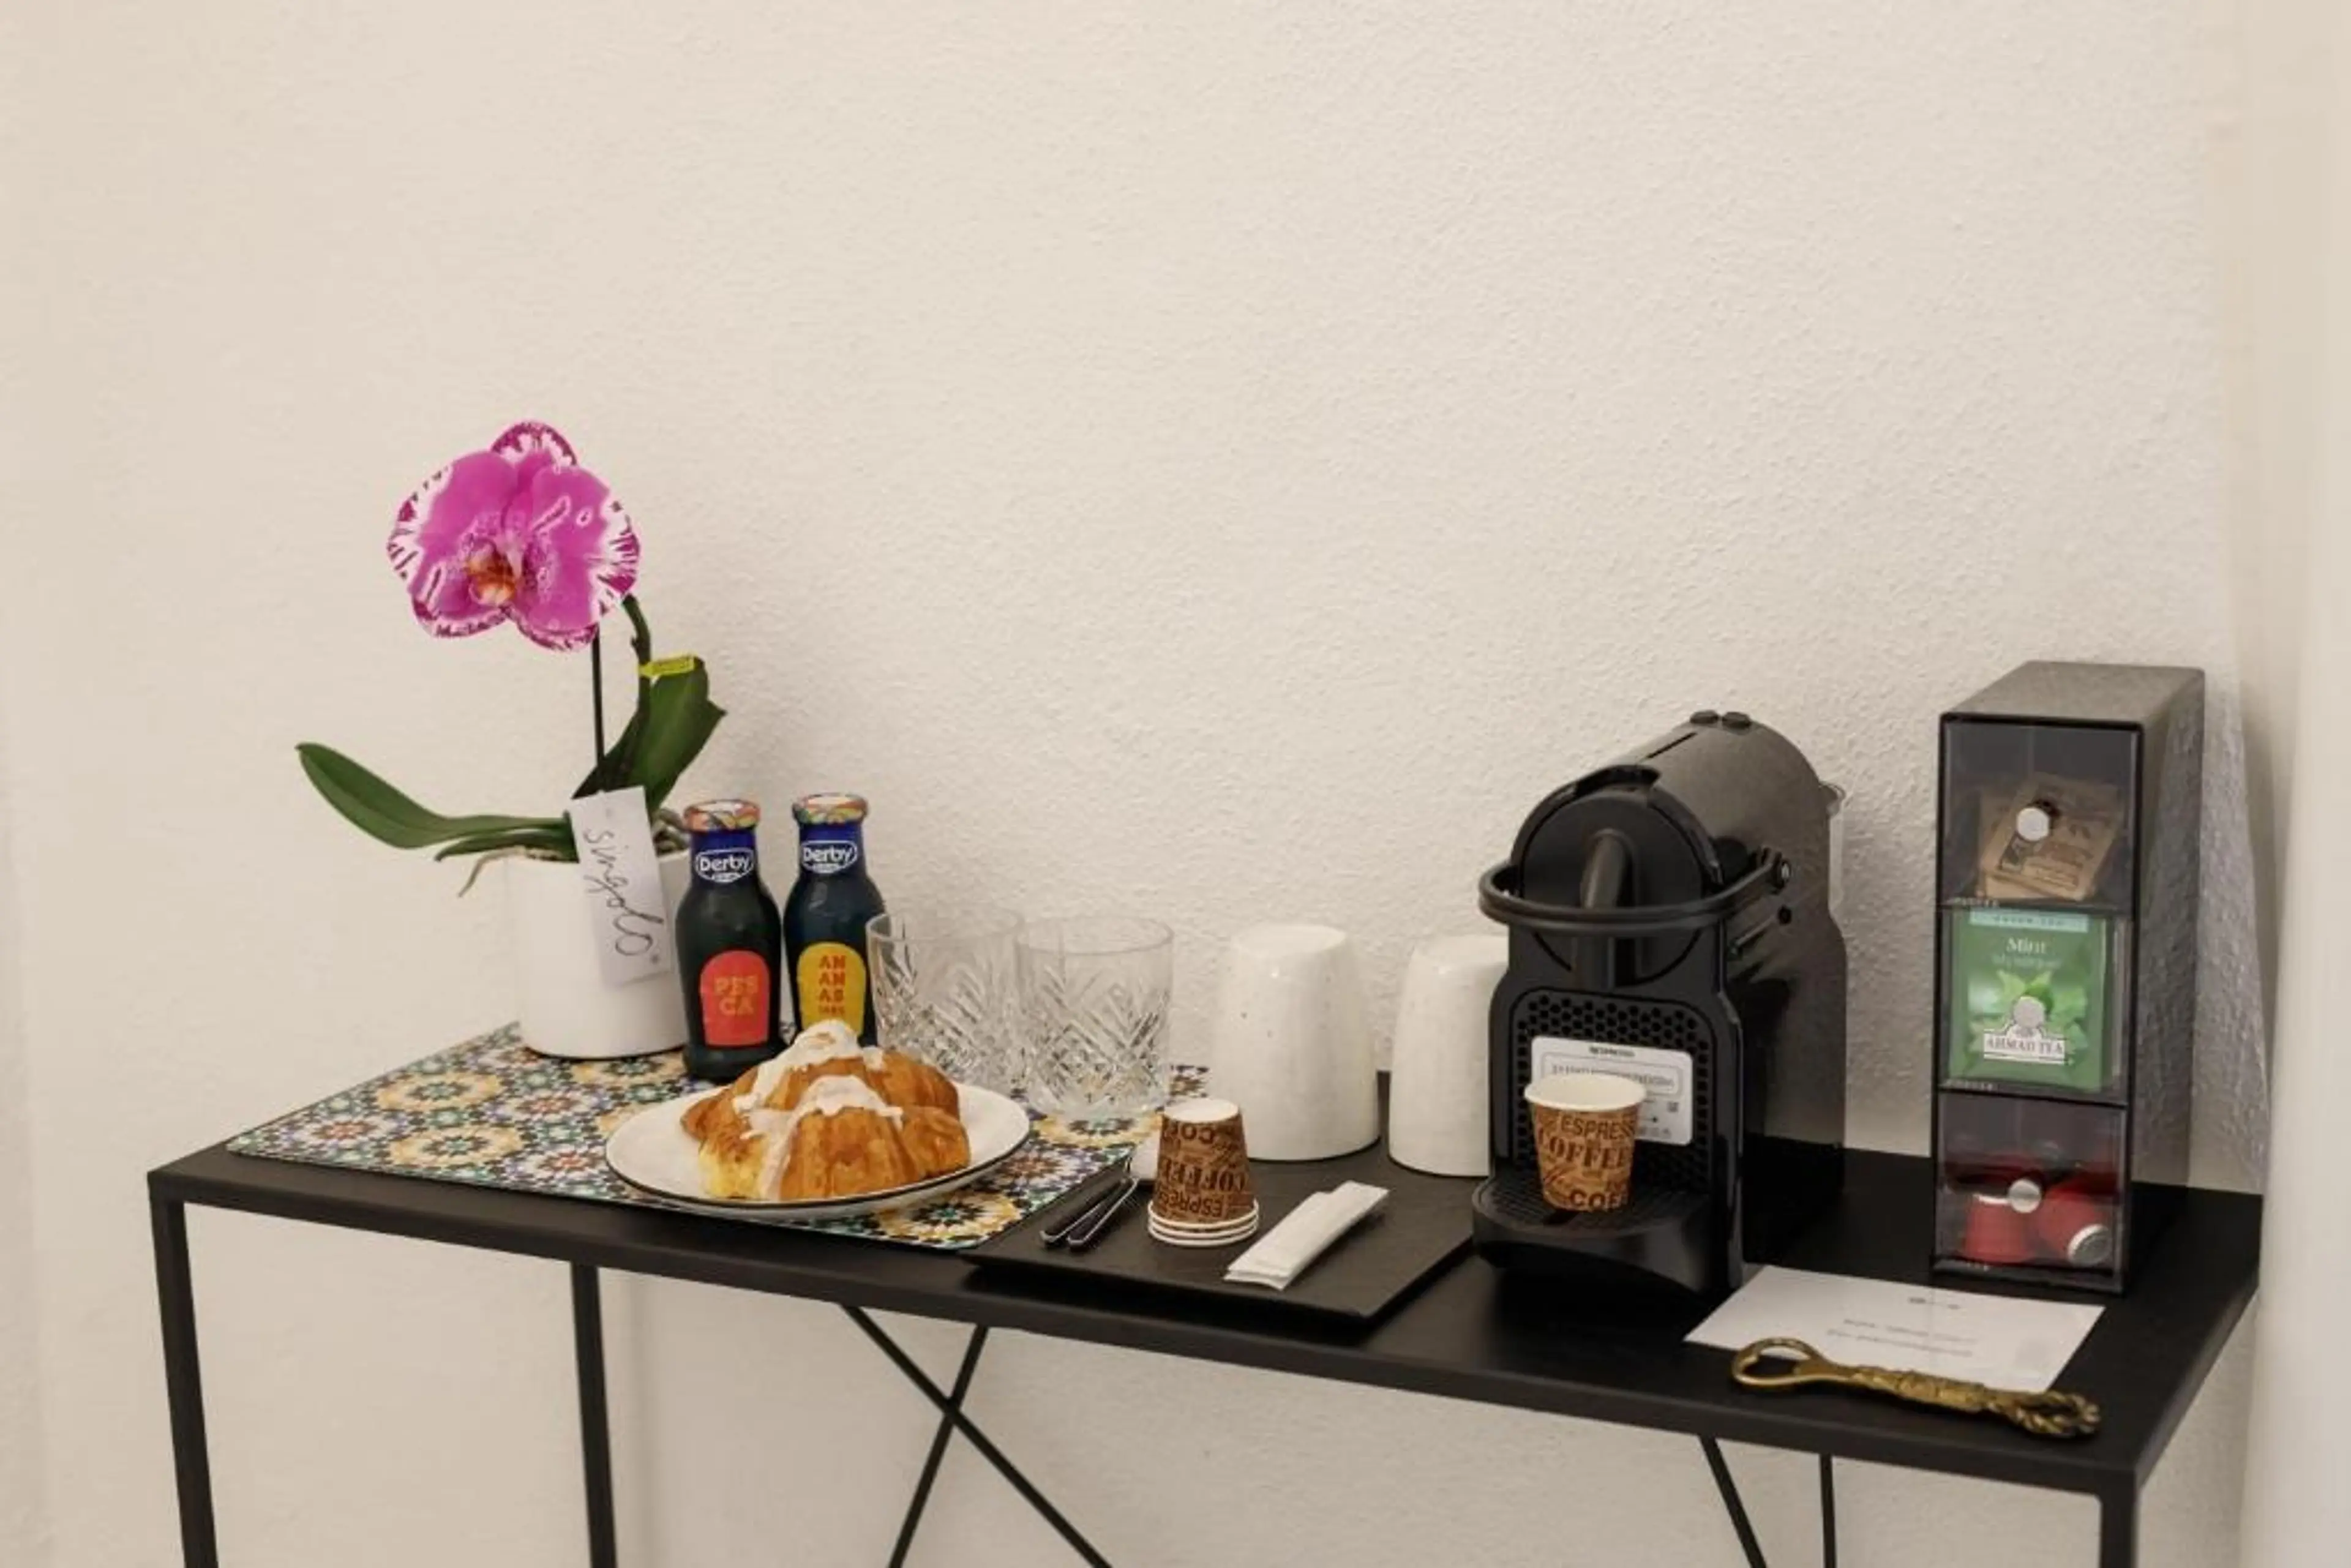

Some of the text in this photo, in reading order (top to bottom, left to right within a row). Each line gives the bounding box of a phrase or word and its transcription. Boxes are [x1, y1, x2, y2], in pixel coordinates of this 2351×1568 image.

[803, 845, 853, 863] Derby
[699, 855, 750, 872] Derby
[2006, 937, 2047, 954] Mint
[819, 955, 846, 969] AN
[714, 976, 759, 995] PES
[819, 972, 846, 986] AN
[819, 989, 844, 1003] AS
[719, 997, 754, 1016] CA
[1986, 1036, 2063, 1055] AHMAD TEA
